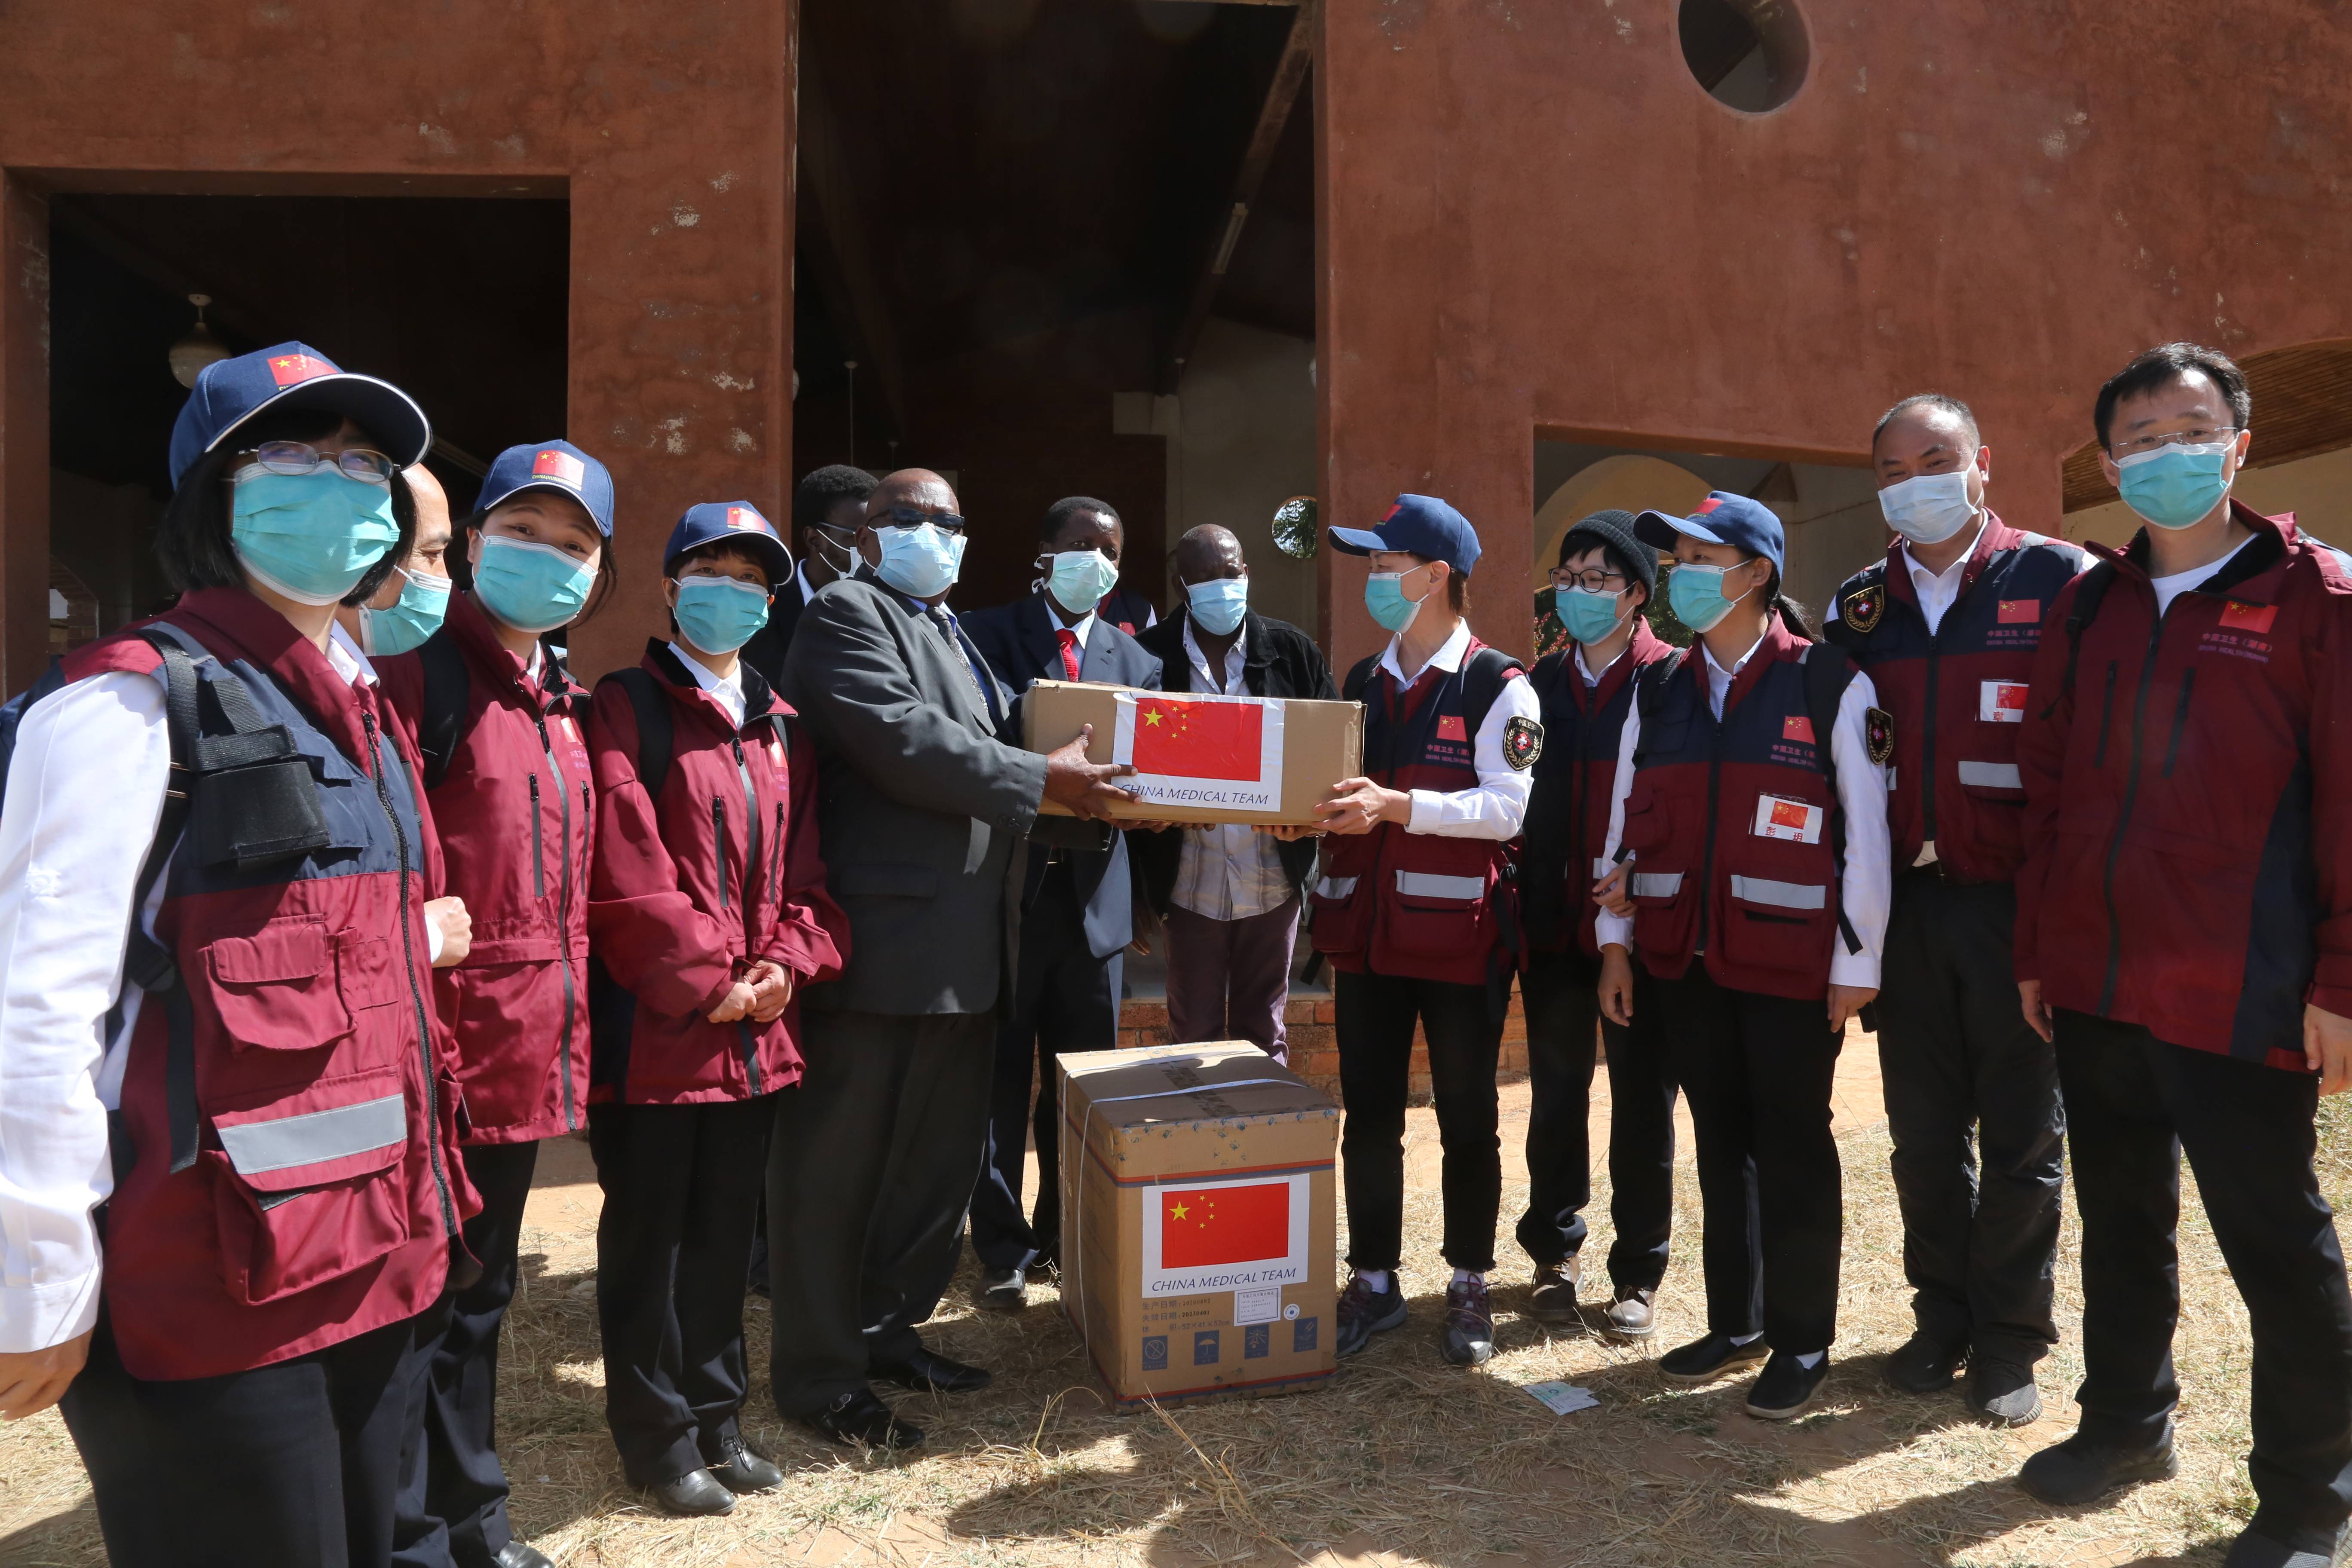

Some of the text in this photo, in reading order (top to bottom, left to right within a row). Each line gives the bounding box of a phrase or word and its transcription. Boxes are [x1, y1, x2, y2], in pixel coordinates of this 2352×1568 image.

[1993, 711, 2004, 721] 章
[1167, 788, 1227, 802] MEDICAL
[1232, 793, 1269, 805] TEAM
[1765, 826, 1776, 836] 彭
[1152, 1268, 1296, 1291] CHINA MEDICAL TEAM
